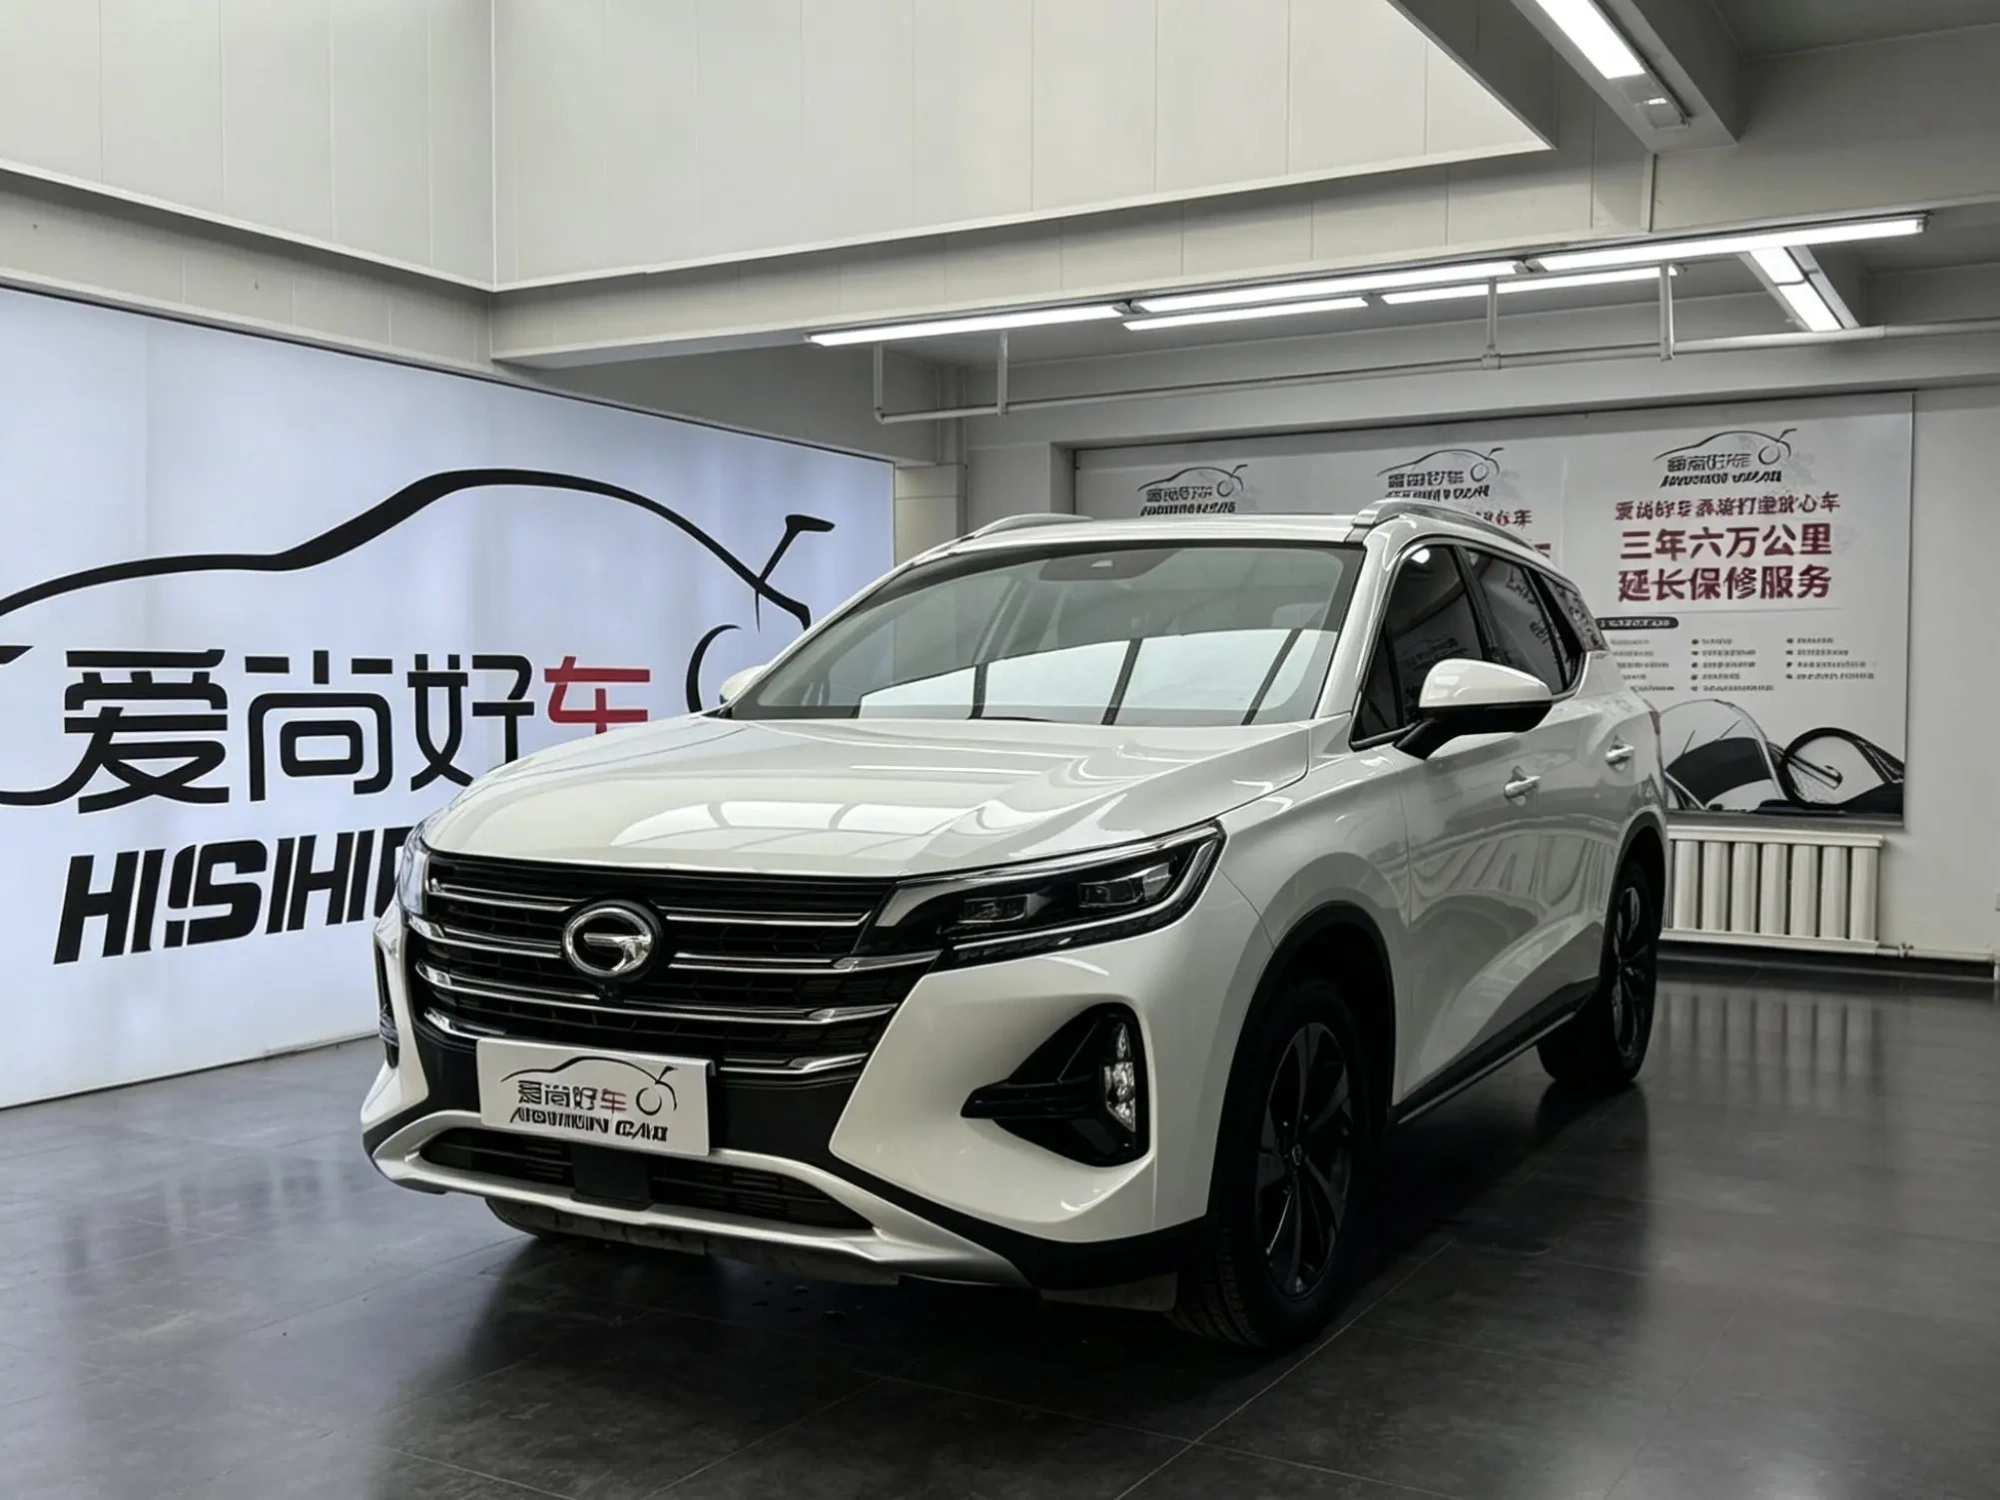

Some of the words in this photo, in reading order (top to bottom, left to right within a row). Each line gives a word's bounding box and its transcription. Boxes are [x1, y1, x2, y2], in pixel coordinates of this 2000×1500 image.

[1620, 523, 1832, 561] 三年六万公里
[1618, 564, 1832, 602] 延长保修服务
